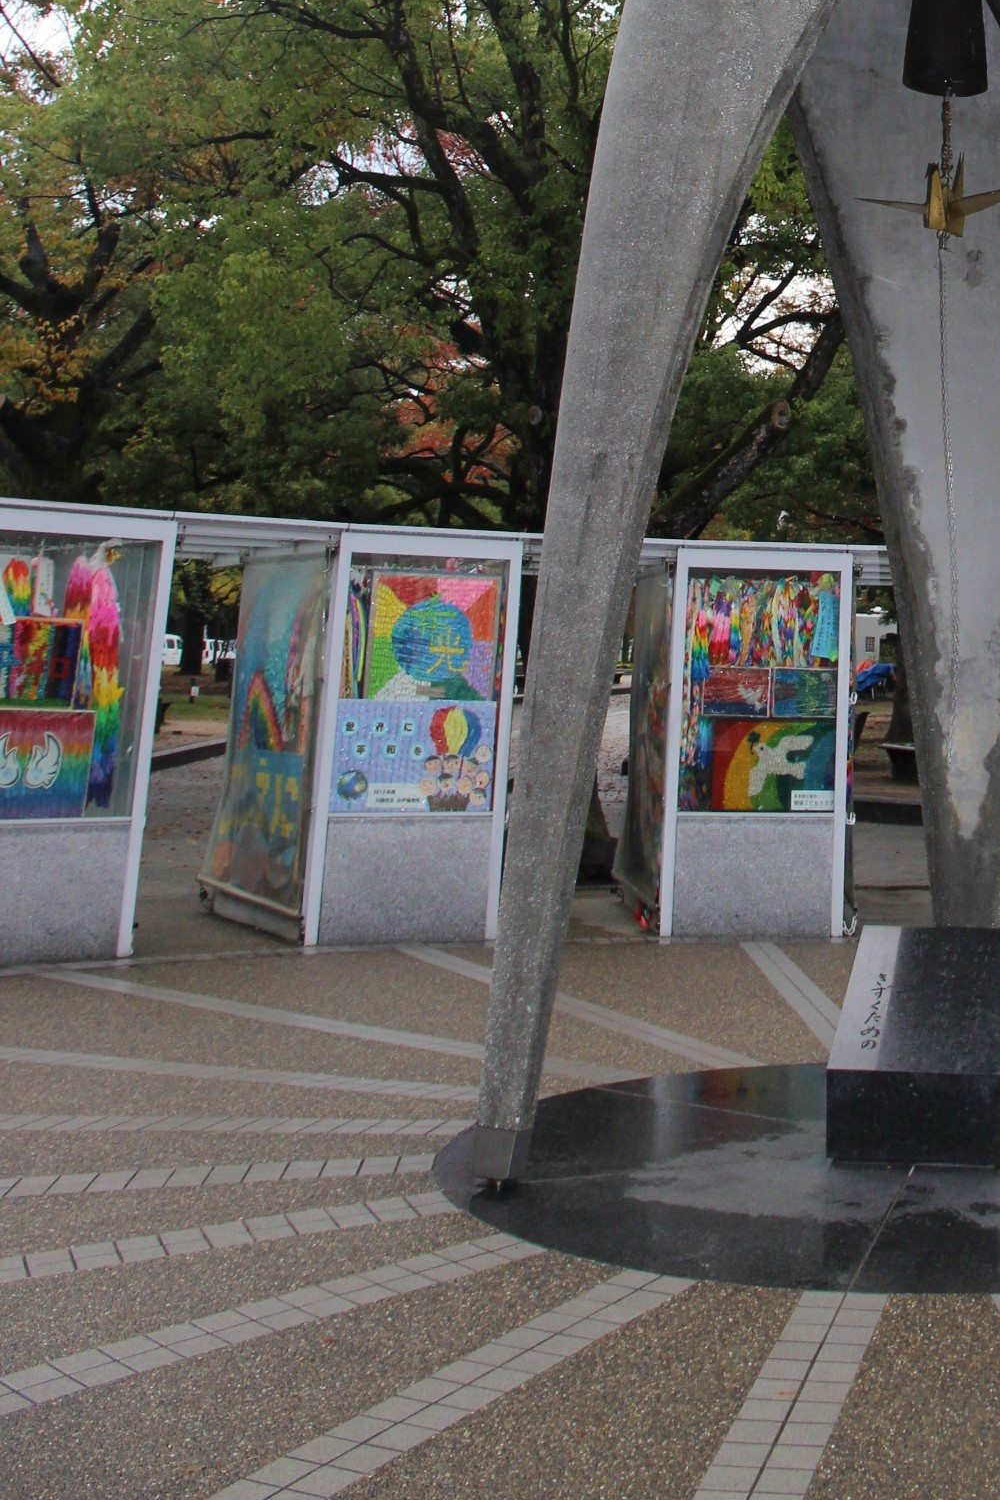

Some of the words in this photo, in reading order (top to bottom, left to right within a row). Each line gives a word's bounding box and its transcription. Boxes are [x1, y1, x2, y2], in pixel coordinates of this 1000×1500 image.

[860, 971, 894, 1050] きずくための
